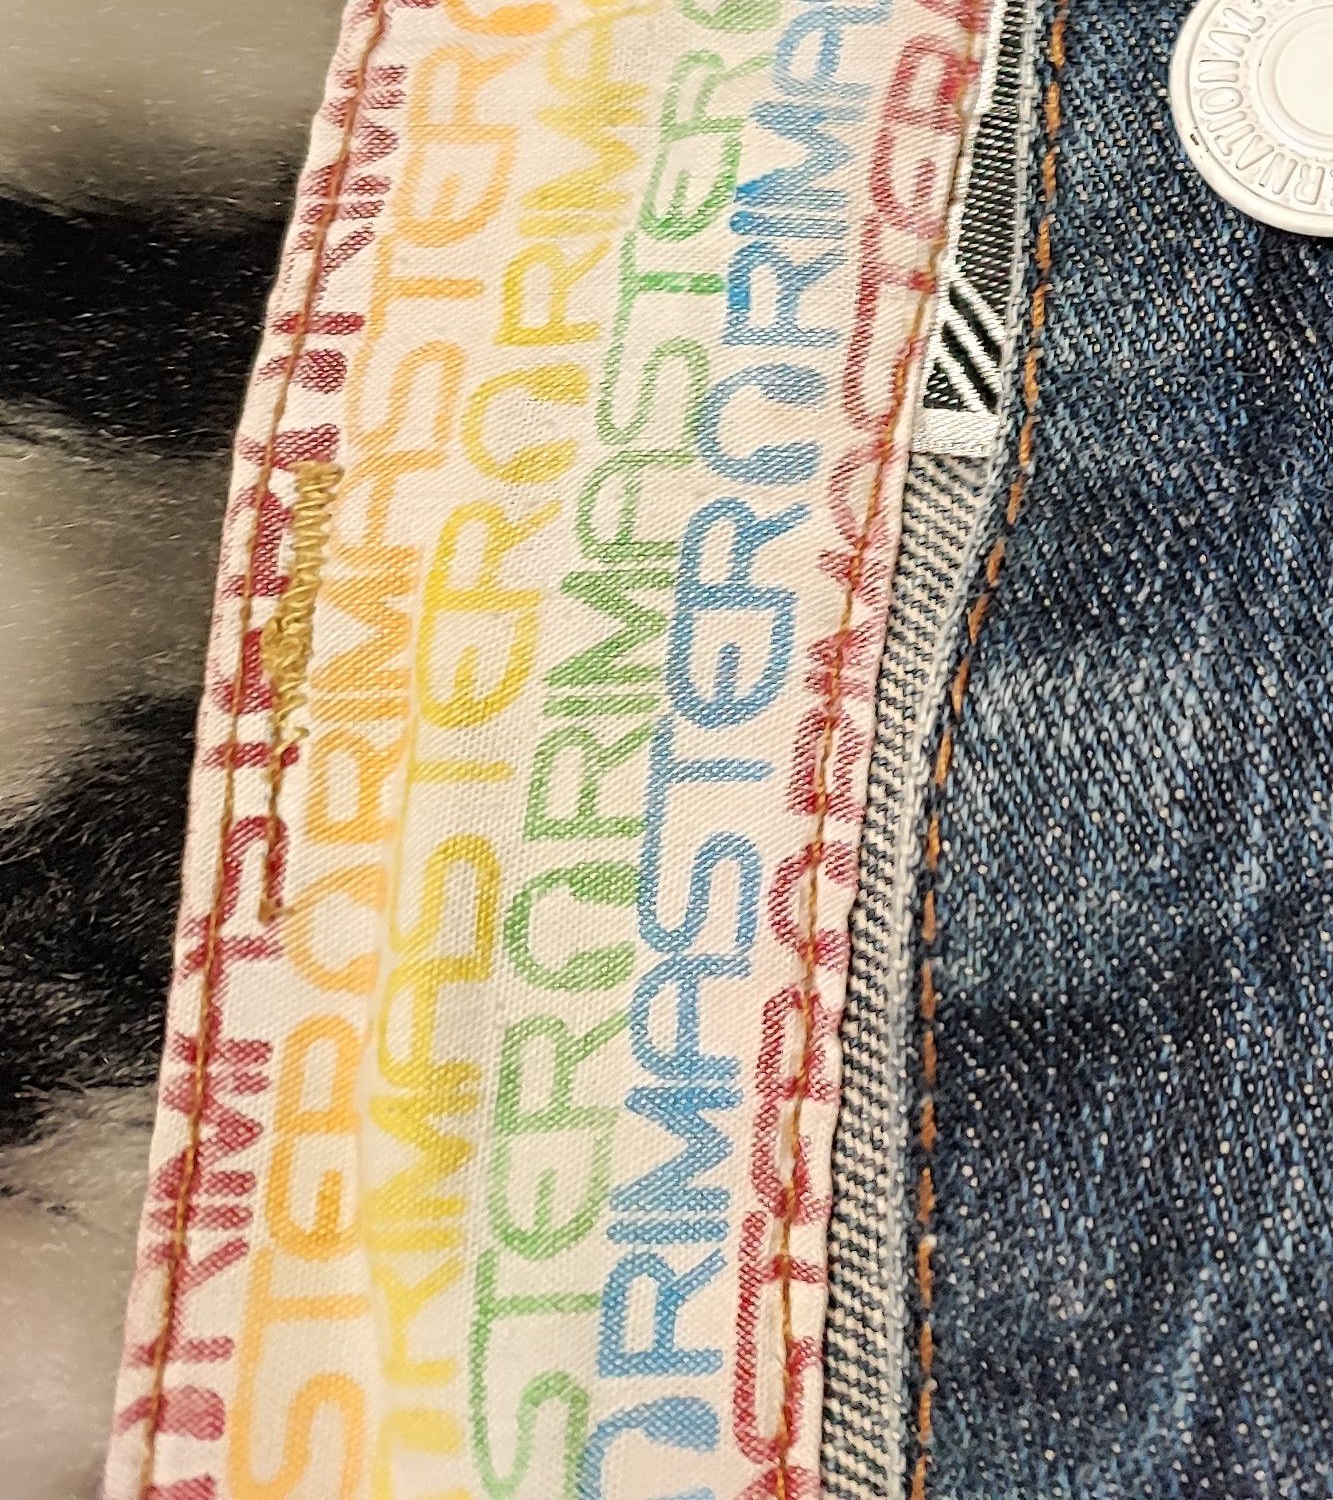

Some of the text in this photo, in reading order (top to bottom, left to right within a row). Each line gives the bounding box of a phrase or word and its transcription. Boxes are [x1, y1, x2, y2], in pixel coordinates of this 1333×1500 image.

[303, 40, 540, 845] RIMASTER
[521, 48, 775, 842] RIMASTER
[364, 497, 565, 1387] RIMASTER
[596, 497, 812, 1378] RIMASTER
